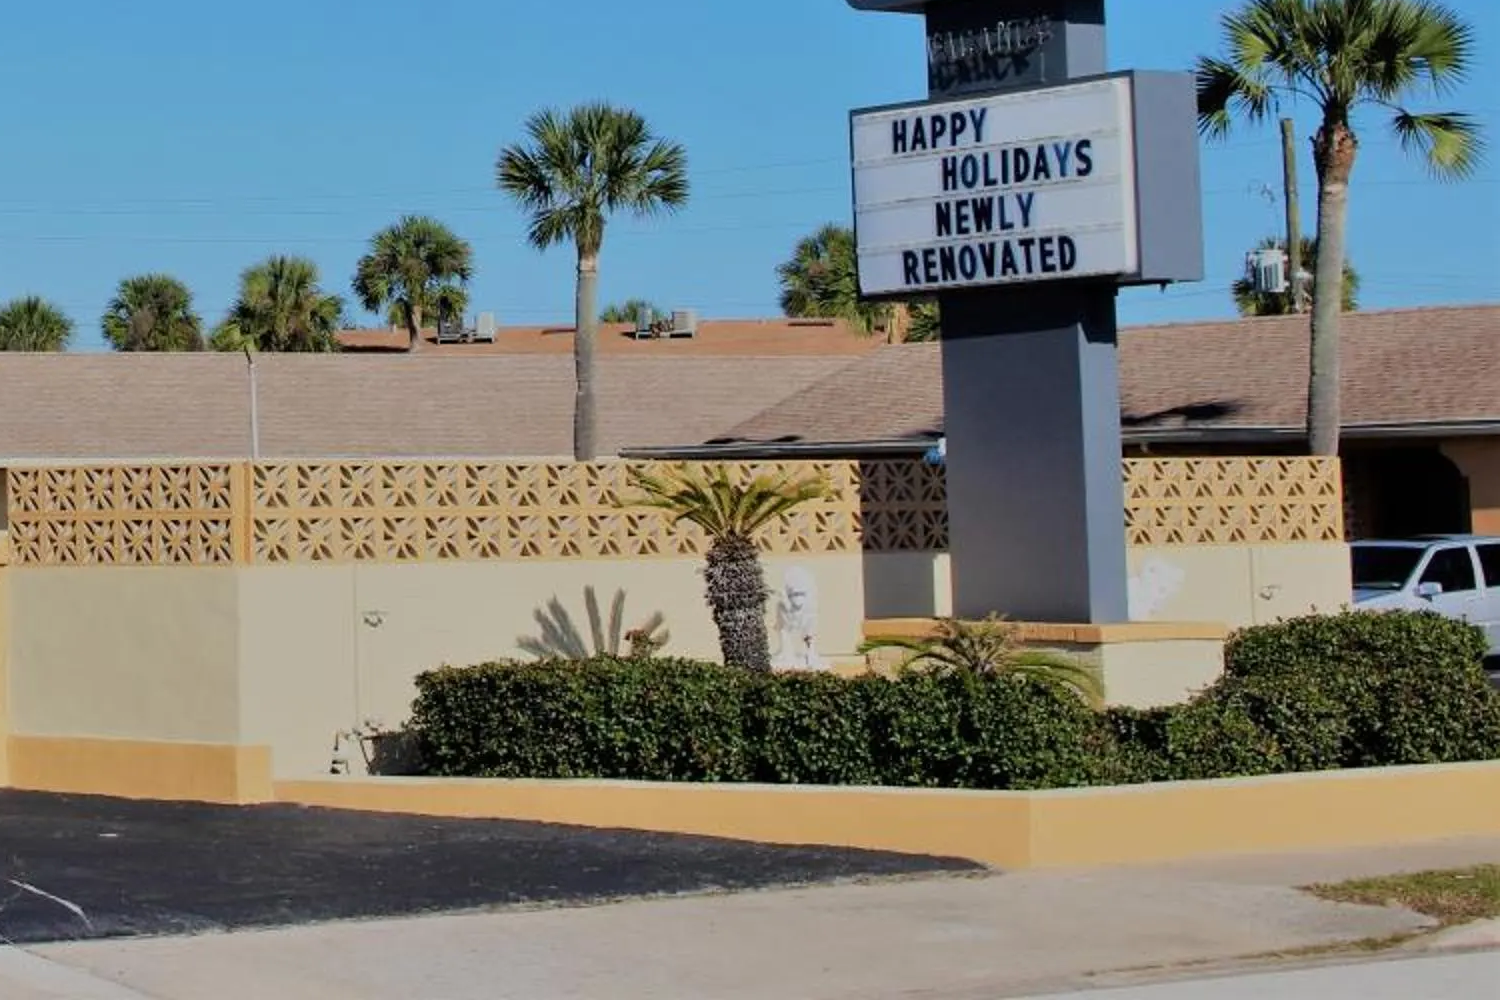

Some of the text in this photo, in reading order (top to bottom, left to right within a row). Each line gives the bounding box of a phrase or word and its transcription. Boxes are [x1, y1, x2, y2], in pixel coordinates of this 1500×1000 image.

[892, 107, 987, 154] HAPPY
[942, 139, 1093, 191] HOLIDAYS
[935, 192, 1034, 237] NEWLY
[902, 235, 1076, 285] RENOVATED
